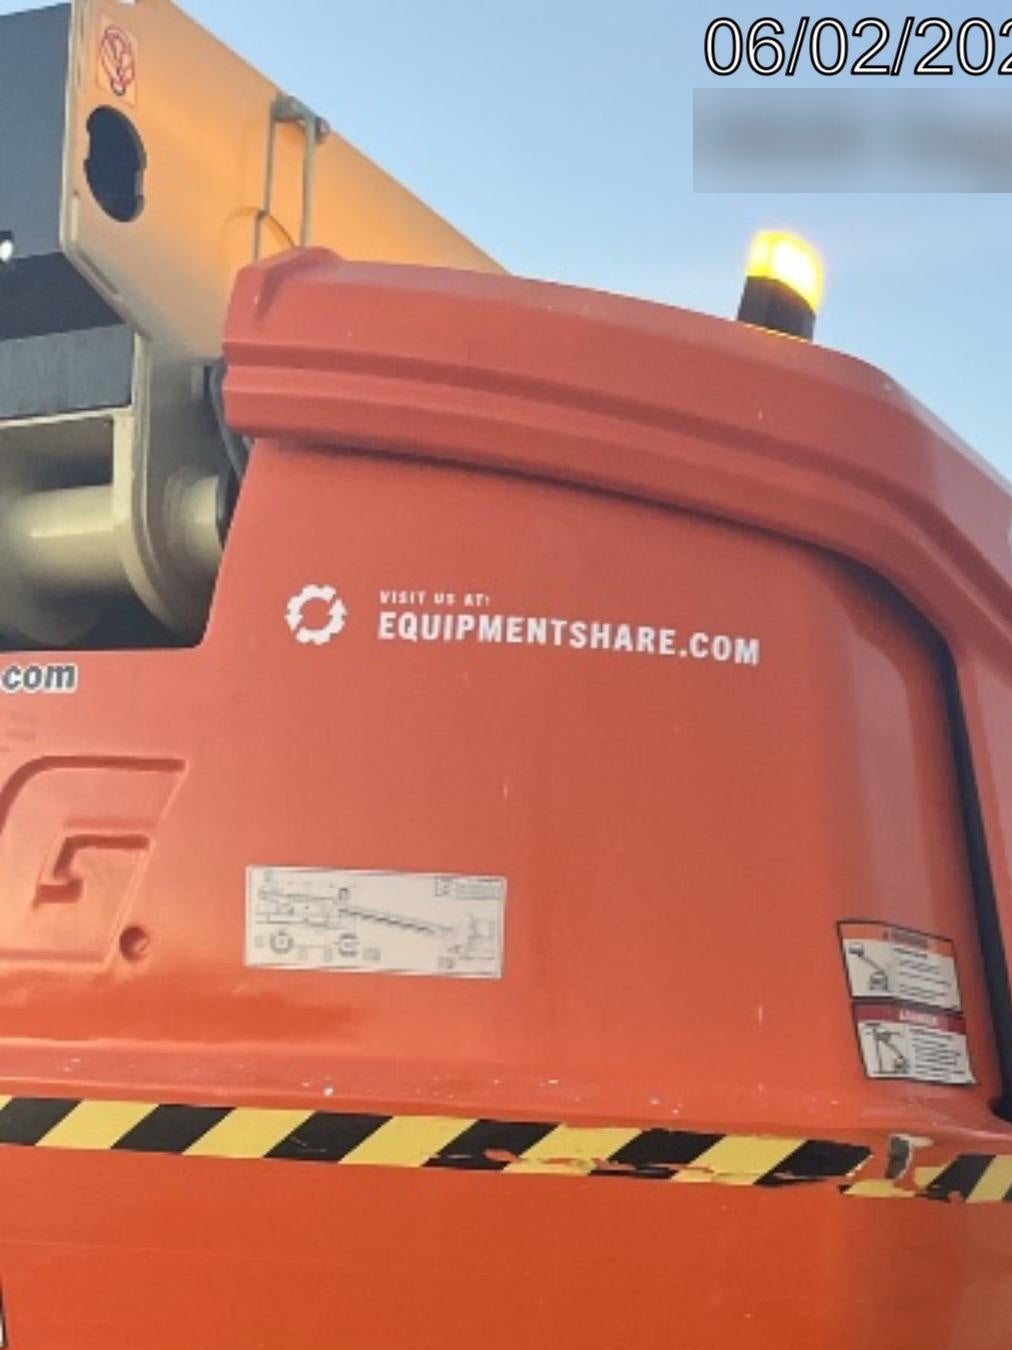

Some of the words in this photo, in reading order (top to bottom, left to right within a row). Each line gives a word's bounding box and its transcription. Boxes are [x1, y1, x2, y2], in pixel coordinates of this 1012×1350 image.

[379, 590, 426, 605] VISIT
[433, 593, 456, 605] US
[378, 610, 761, 667] EQUIPMENTSHARE.COM
